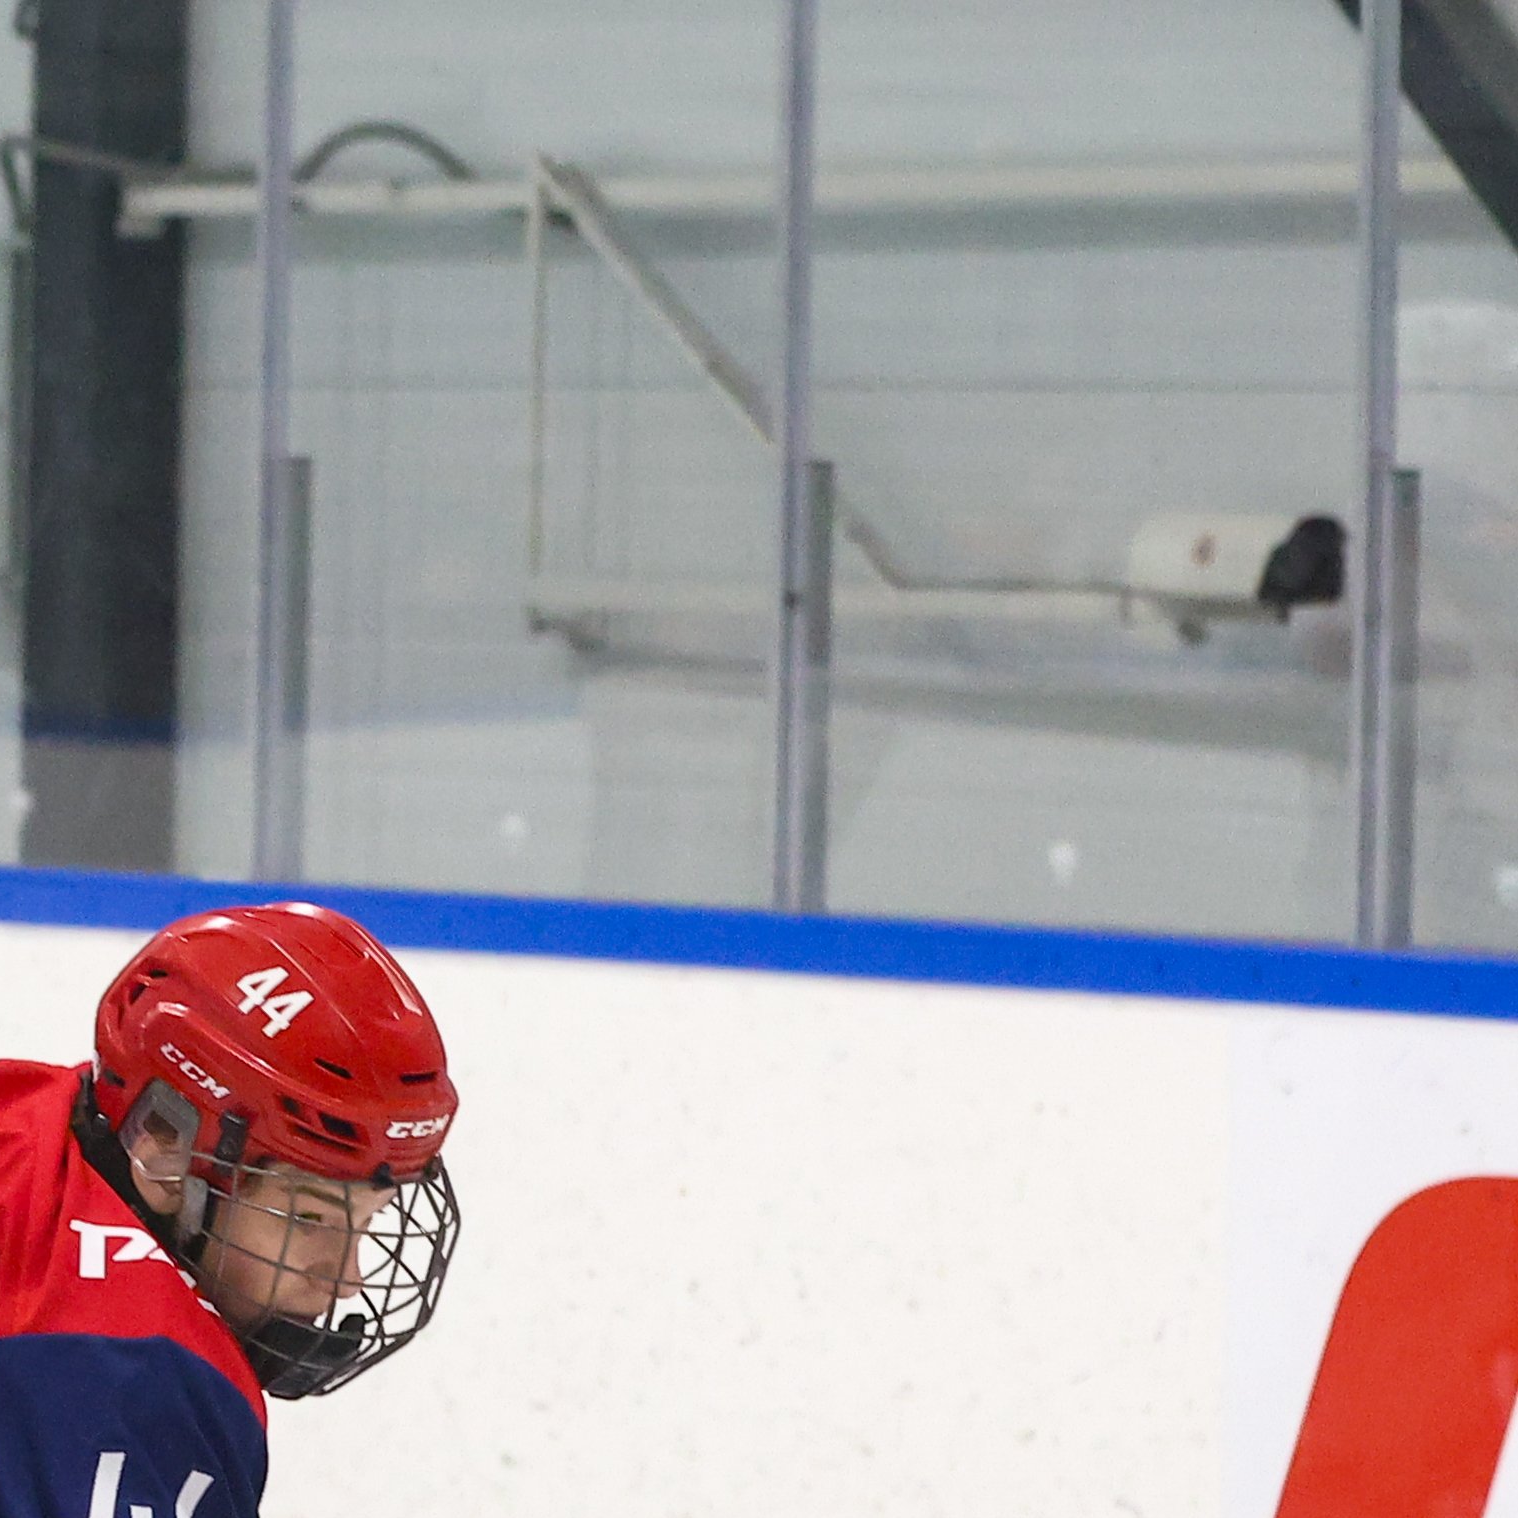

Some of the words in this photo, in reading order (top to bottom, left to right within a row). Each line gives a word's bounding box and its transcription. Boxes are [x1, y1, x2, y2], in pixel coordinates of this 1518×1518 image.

[236, 966, 315, 1038] 44
[159, 1042, 231, 1100] CCM
[384, 1114, 450, 1139] CCM
